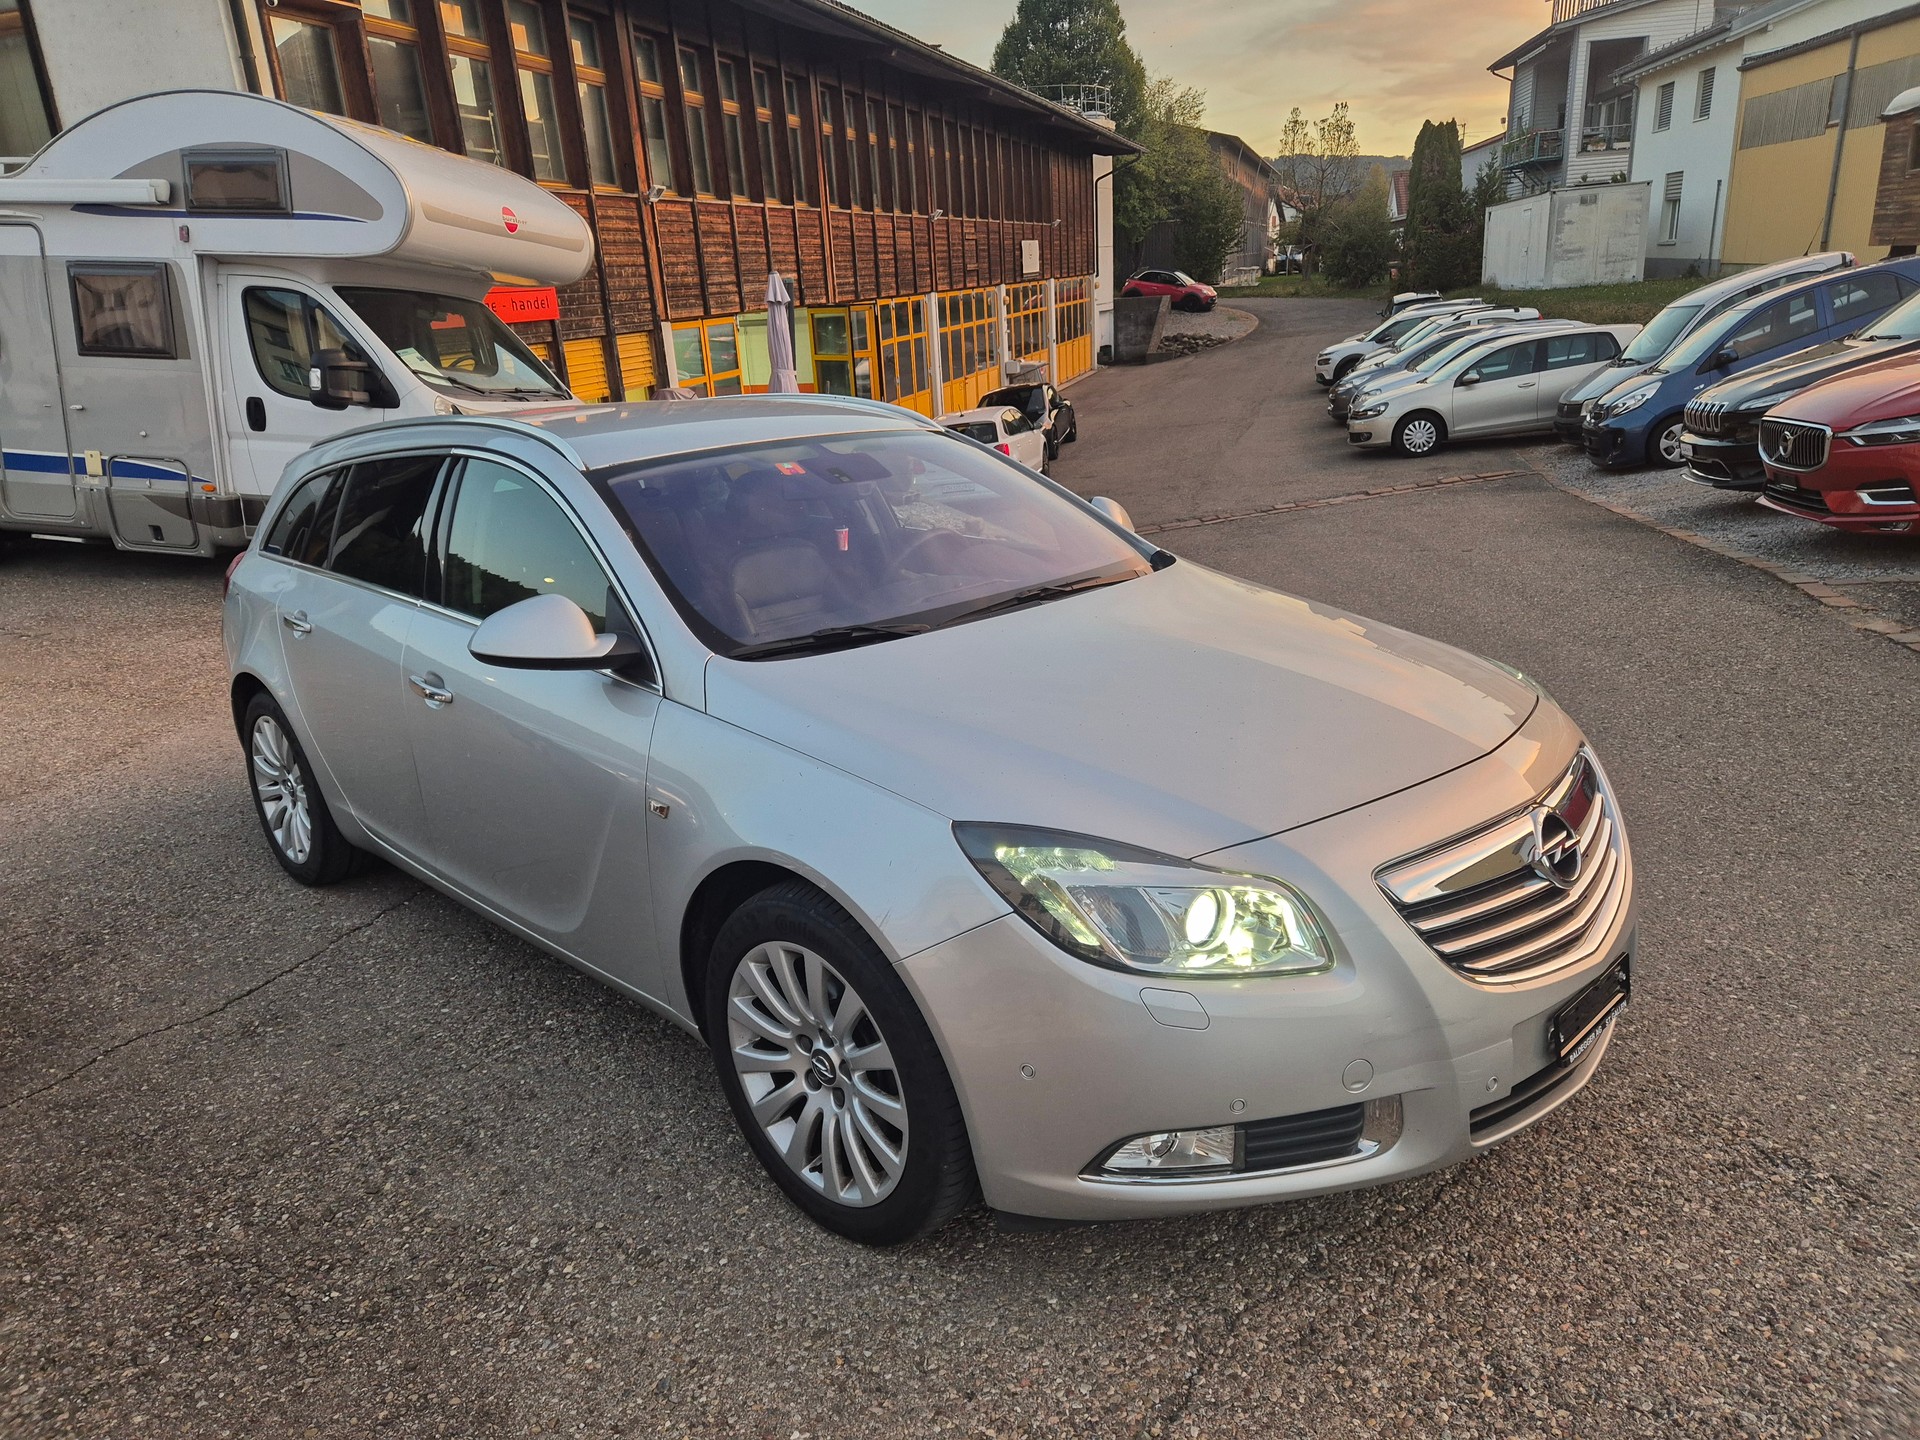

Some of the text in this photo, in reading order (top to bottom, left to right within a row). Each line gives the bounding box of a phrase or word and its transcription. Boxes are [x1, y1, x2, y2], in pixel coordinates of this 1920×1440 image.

[511, 296, 550, 311] handel
[1570, 1032, 1596, 1063] BALDEGGER
[1595, 1025, 1603, 1038] AG
